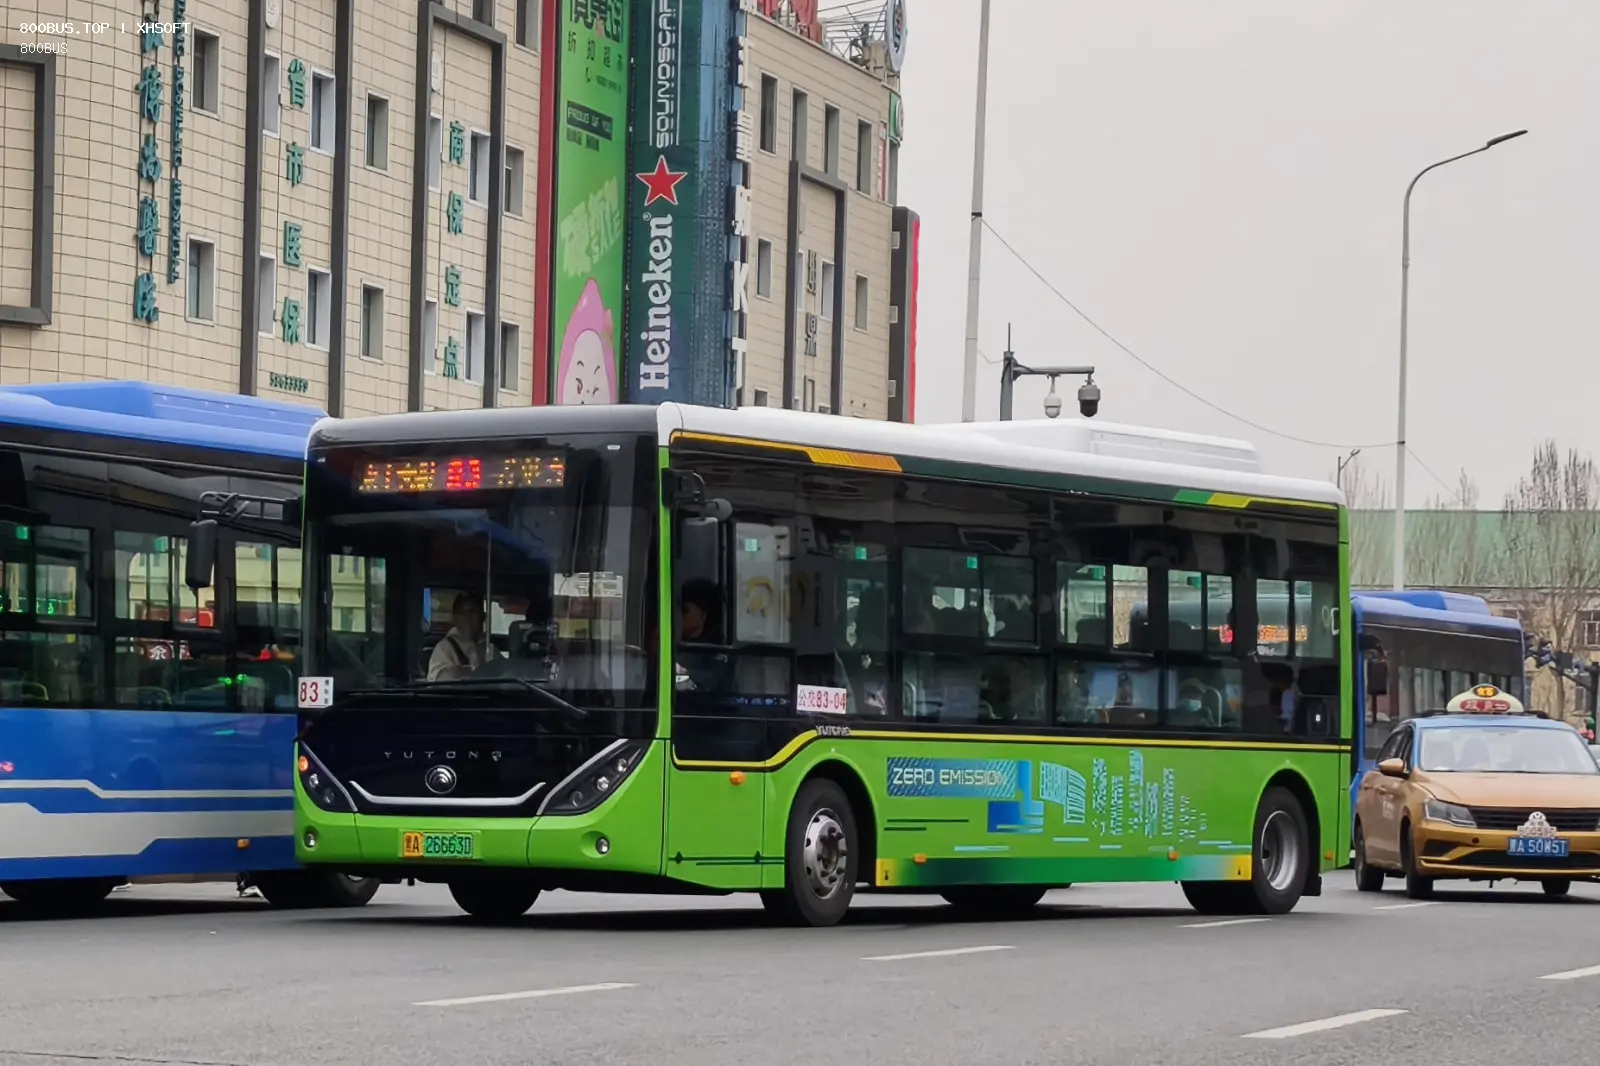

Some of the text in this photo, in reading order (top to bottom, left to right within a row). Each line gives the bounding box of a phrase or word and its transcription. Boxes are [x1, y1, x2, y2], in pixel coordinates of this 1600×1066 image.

[639, 212, 674, 390] Heineken
[300, 681, 319, 702] 83
[892, 767, 936, 786] ZERO
